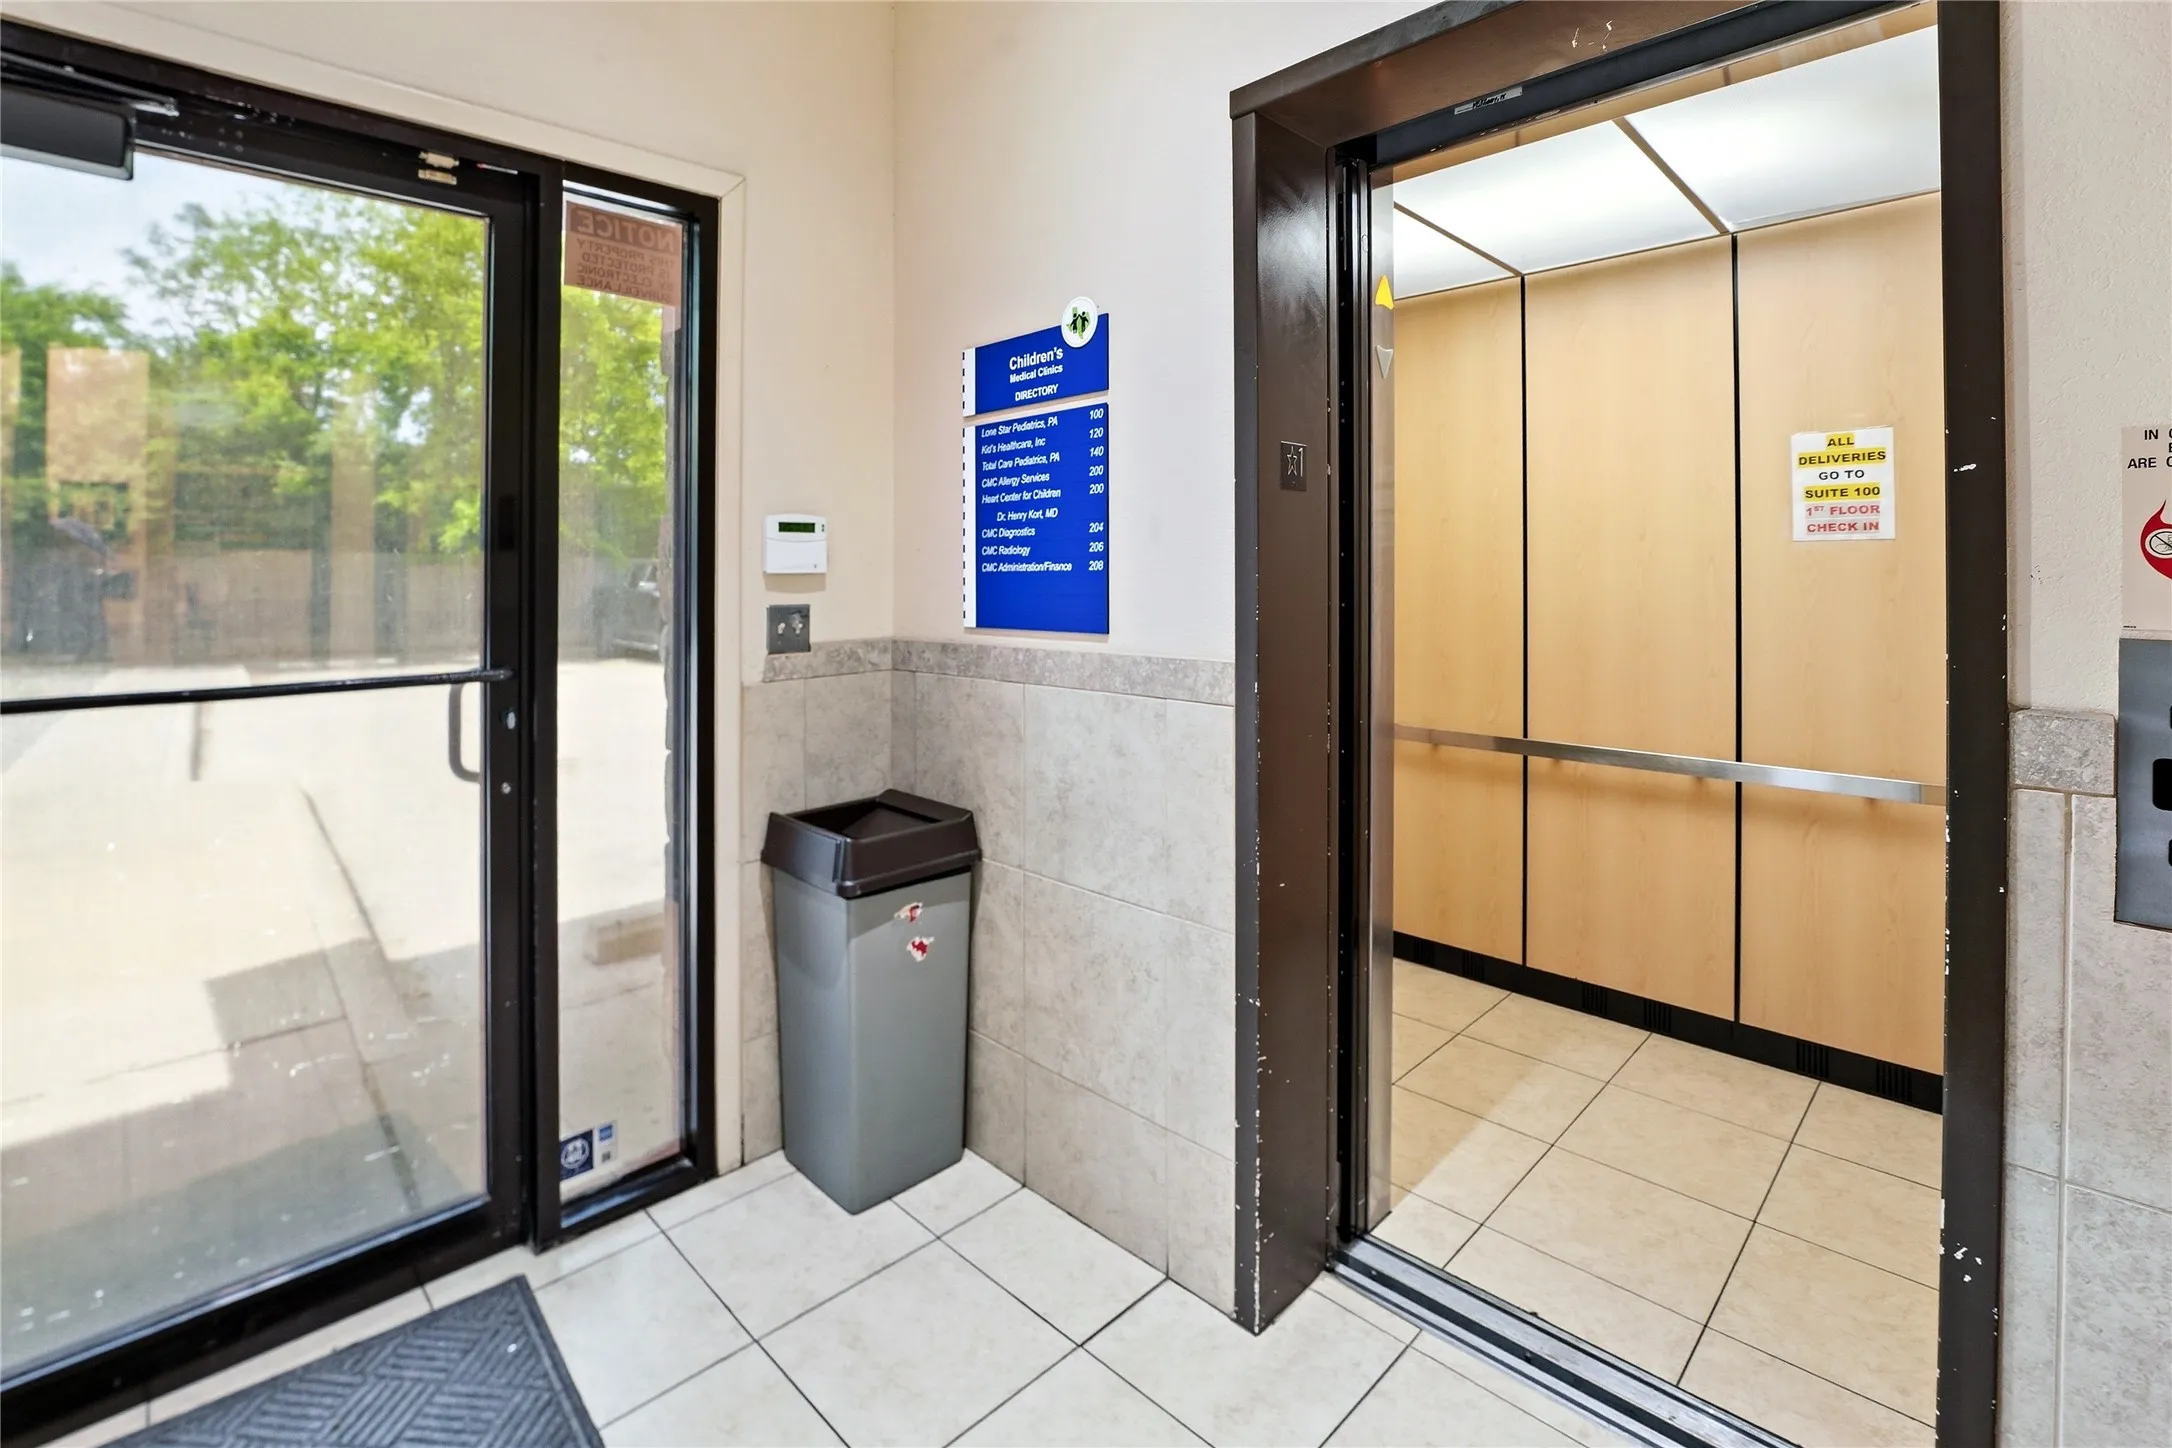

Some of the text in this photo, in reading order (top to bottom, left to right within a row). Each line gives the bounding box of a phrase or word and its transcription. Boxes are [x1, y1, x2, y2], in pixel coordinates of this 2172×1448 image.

[1009, 347, 1064, 370] Children's
[1009, 364, 1064, 384] Medical Clinics
[1015, 384, 1059, 401] DIRECTORY
[981, 408, 1104, 438] Lone Star Pediatrics, PA 100
[981, 427, 1104, 455] Kid's Healthcare, Inc 120
[2144, 428, 2159, 440] IN
[1827, 437, 1855, 447] ALL
[982, 446, 1104, 472] Total Care Pediatrics, PA 140
[1798, 451, 1886, 466] DELIVERIES
[2127, 456, 2157, 469] ARE
[981, 465, 1104, 488] CMC Allergy Services 200
[1818, 469, 1865, 481] GO TO
[982, 483, 1104, 504] Heart Center for Children 200
[1805, 486, 1880, 499] SUITE 100
[996, 512, 1006, 521] Dr.
[1007, 510, 1028, 521] Henry
[1045, 507, 1058, 518] MD
[1806, 504, 1880, 516] 1ST FLOOR
[981, 522, 1104, 539] CMC Diagnostics 204
[1807, 521, 1879, 533] CHECK IN
[981, 541, 1104, 556] CMC Radiology 206
[981, 560, 1104, 573] CMC Administration/Finance 208
